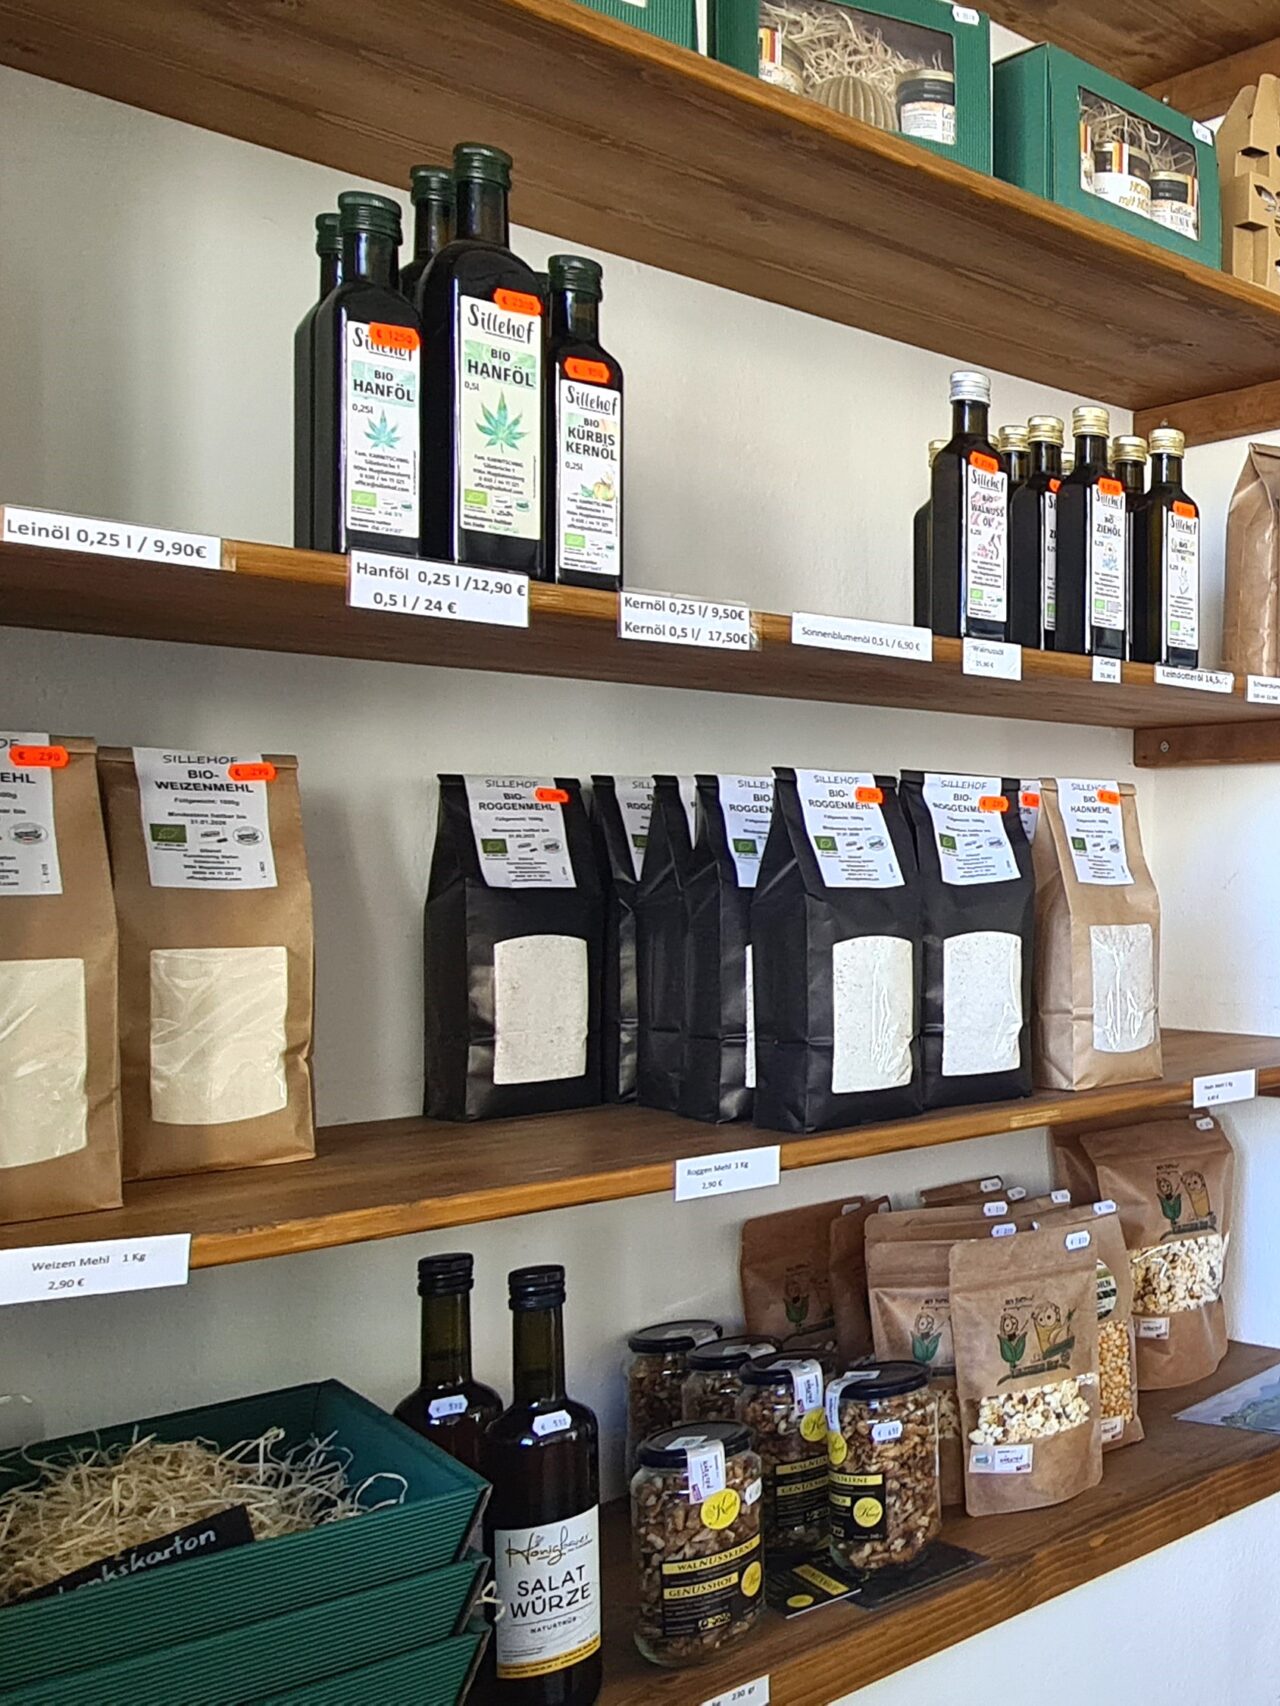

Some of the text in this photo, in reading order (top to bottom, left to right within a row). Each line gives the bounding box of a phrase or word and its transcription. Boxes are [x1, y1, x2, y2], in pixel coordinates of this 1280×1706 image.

[467, 303, 535, 344] Sillehof
[491, 348, 511, 362] BIO
[374, 369, 394, 381] BIO
[467, 359, 534, 388] HANFÖL
[353, 378, 414, 402] HANFÖL
[565, 385, 618, 416] Sillehof
[583, 418, 600, 429] BIO
[568, 425, 616, 447] KÜRBIS
[566, 441, 617, 462] KERNÖL
[7, 519, 70, 541] Leinöl
[77, 529, 120, 547] 0,25
[153, 540, 207, 559] 9,90€
[356, 562, 409, 580] Hanföl
[417, 571, 451, 587] 0,25
[517, 584, 526, 597] €
[373, 592, 397, 607] 0,5
[411, 596, 420, 611] /
[424, 599, 443, 612] 24
[448, 602, 457, 614] €
[624, 596, 666, 612] Kernöl
[669, 602, 696, 616] 0,25
[711, 607, 745, 621] 9,50€
[624, 621, 666, 636] Kernöl
[669, 626, 688, 639] 0,5
[708, 630, 748, 644] 17,50€
[801, 626, 870, 644] Sonnenblumenöl
[162, 754, 238, 765] SILLEHOF
[187, 769, 219, 780] BIO-
[485, 779, 539, 788] SILLEHOF
[813, 775, 860, 785] SILLEHOF
[940, 779, 988, 790] SILLEHOF
[154, 781, 254, 793] WEIZENMEHL
[478, 802, 556, 811] ROGGENMEHL
[729, 804, 773, 813] ROGGEN
[32, 1252, 146, 1272] Weizen Mehl 1 Kg
[48, 1278, 85, 1290] 2,90 €
[516, 1564, 586, 1597] SALAT
[510, 1582, 591, 1619] WÜRZE
